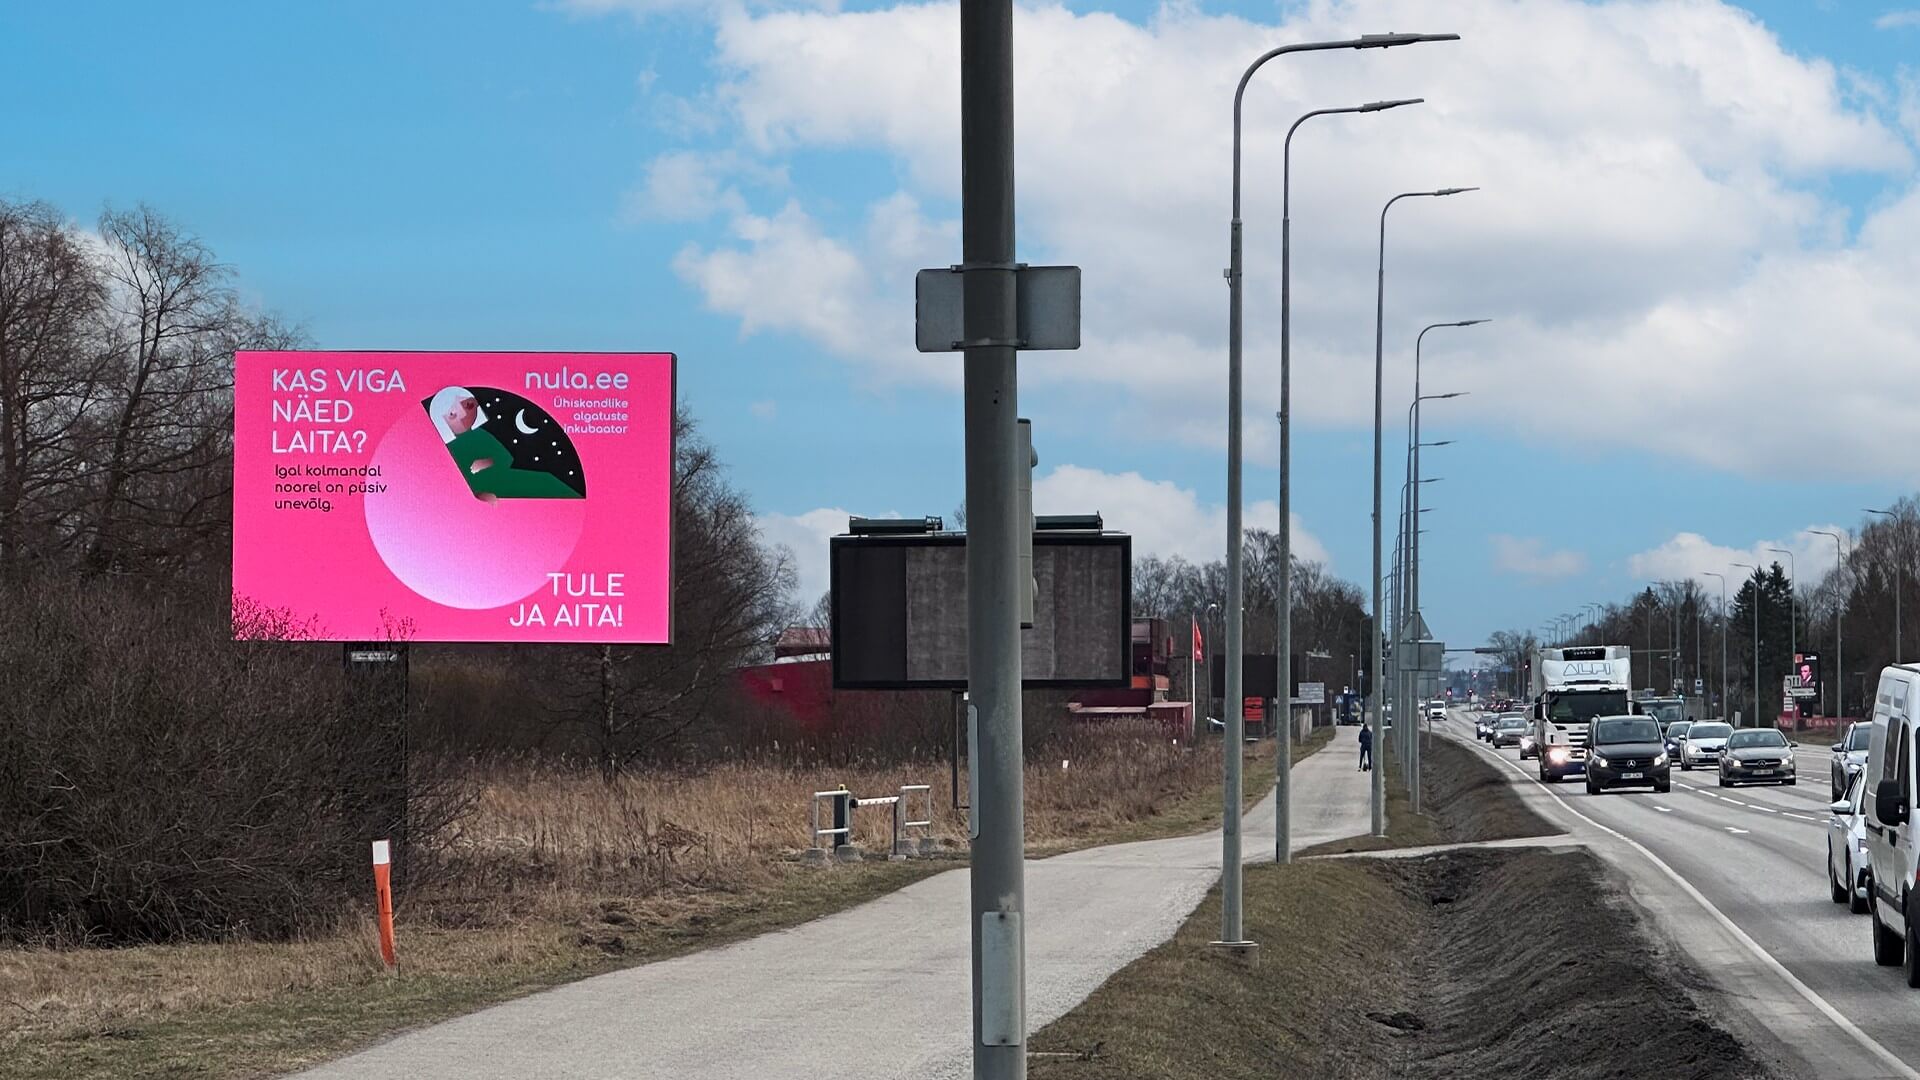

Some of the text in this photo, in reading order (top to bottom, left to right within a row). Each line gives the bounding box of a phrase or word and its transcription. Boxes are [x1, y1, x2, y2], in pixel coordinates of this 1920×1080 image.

[272, 368, 406, 393] KAS VIGA
[525, 365, 629, 390] nula.ee
[272, 393, 353, 423] NÄED
[553, 396, 629, 408] Ühiskondlike
[573, 411, 629, 424] algatuste
[272, 430, 367, 454] LAITA?
[275, 464, 381, 479] Igal kolmandal
[275, 481, 387, 496] noorel on püsiv
[274, 497, 334, 512] unevõlg.
[546, 572, 625, 597] TULE
[509, 603, 623, 627] JA AITA!
